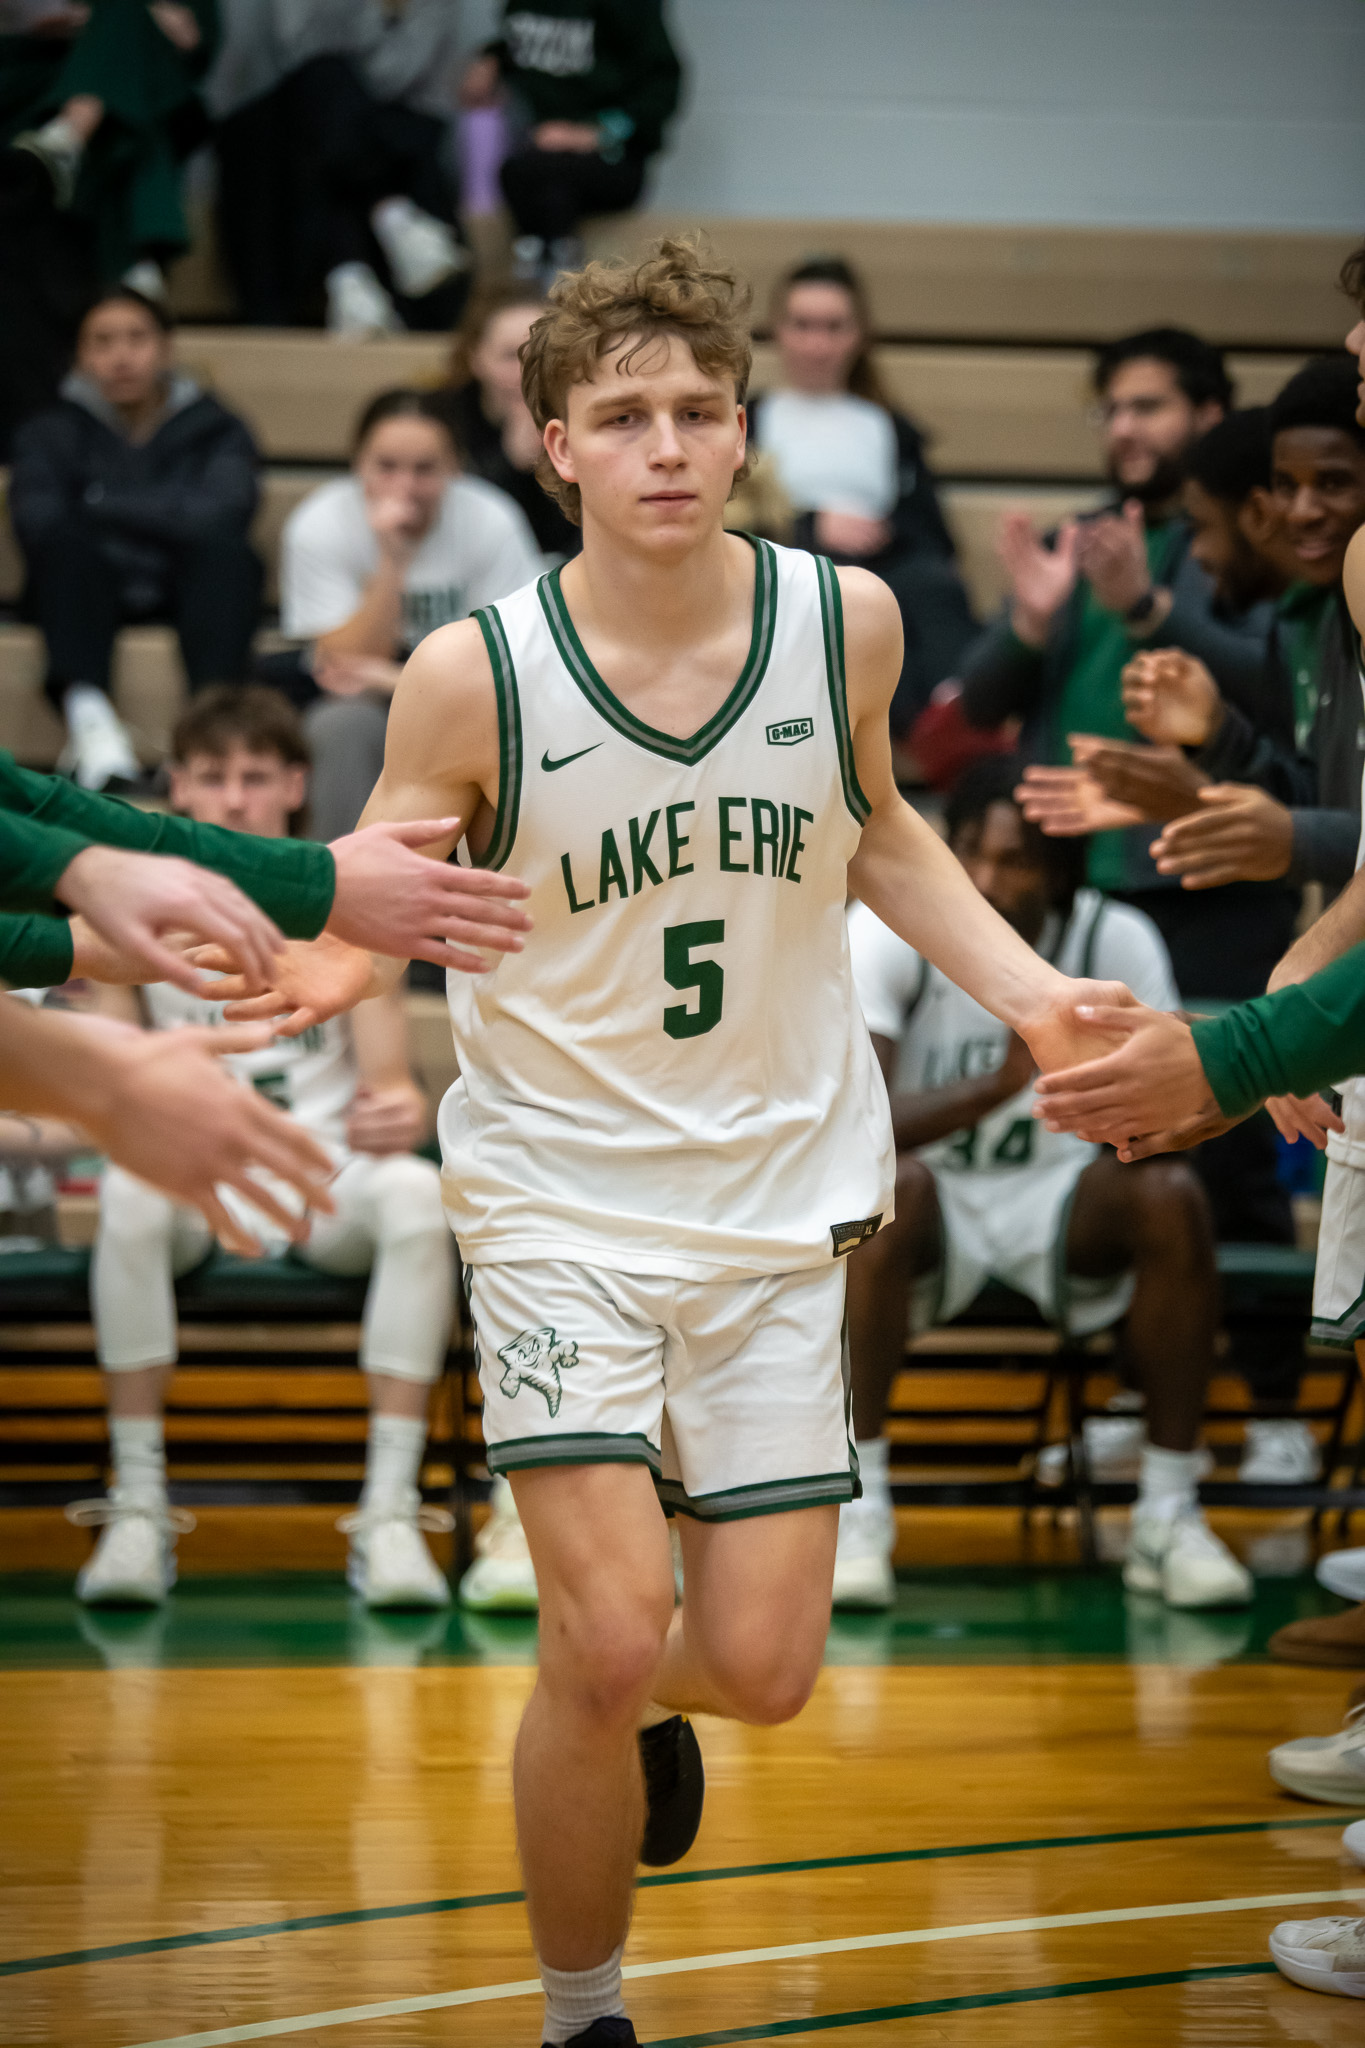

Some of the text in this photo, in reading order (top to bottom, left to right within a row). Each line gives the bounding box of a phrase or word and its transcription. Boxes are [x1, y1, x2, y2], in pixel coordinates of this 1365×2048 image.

[772, 722, 809, 741] G-MAC
[560, 796, 814, 914] LAKE ERIE
[663, 919, 725, 1040] 5
